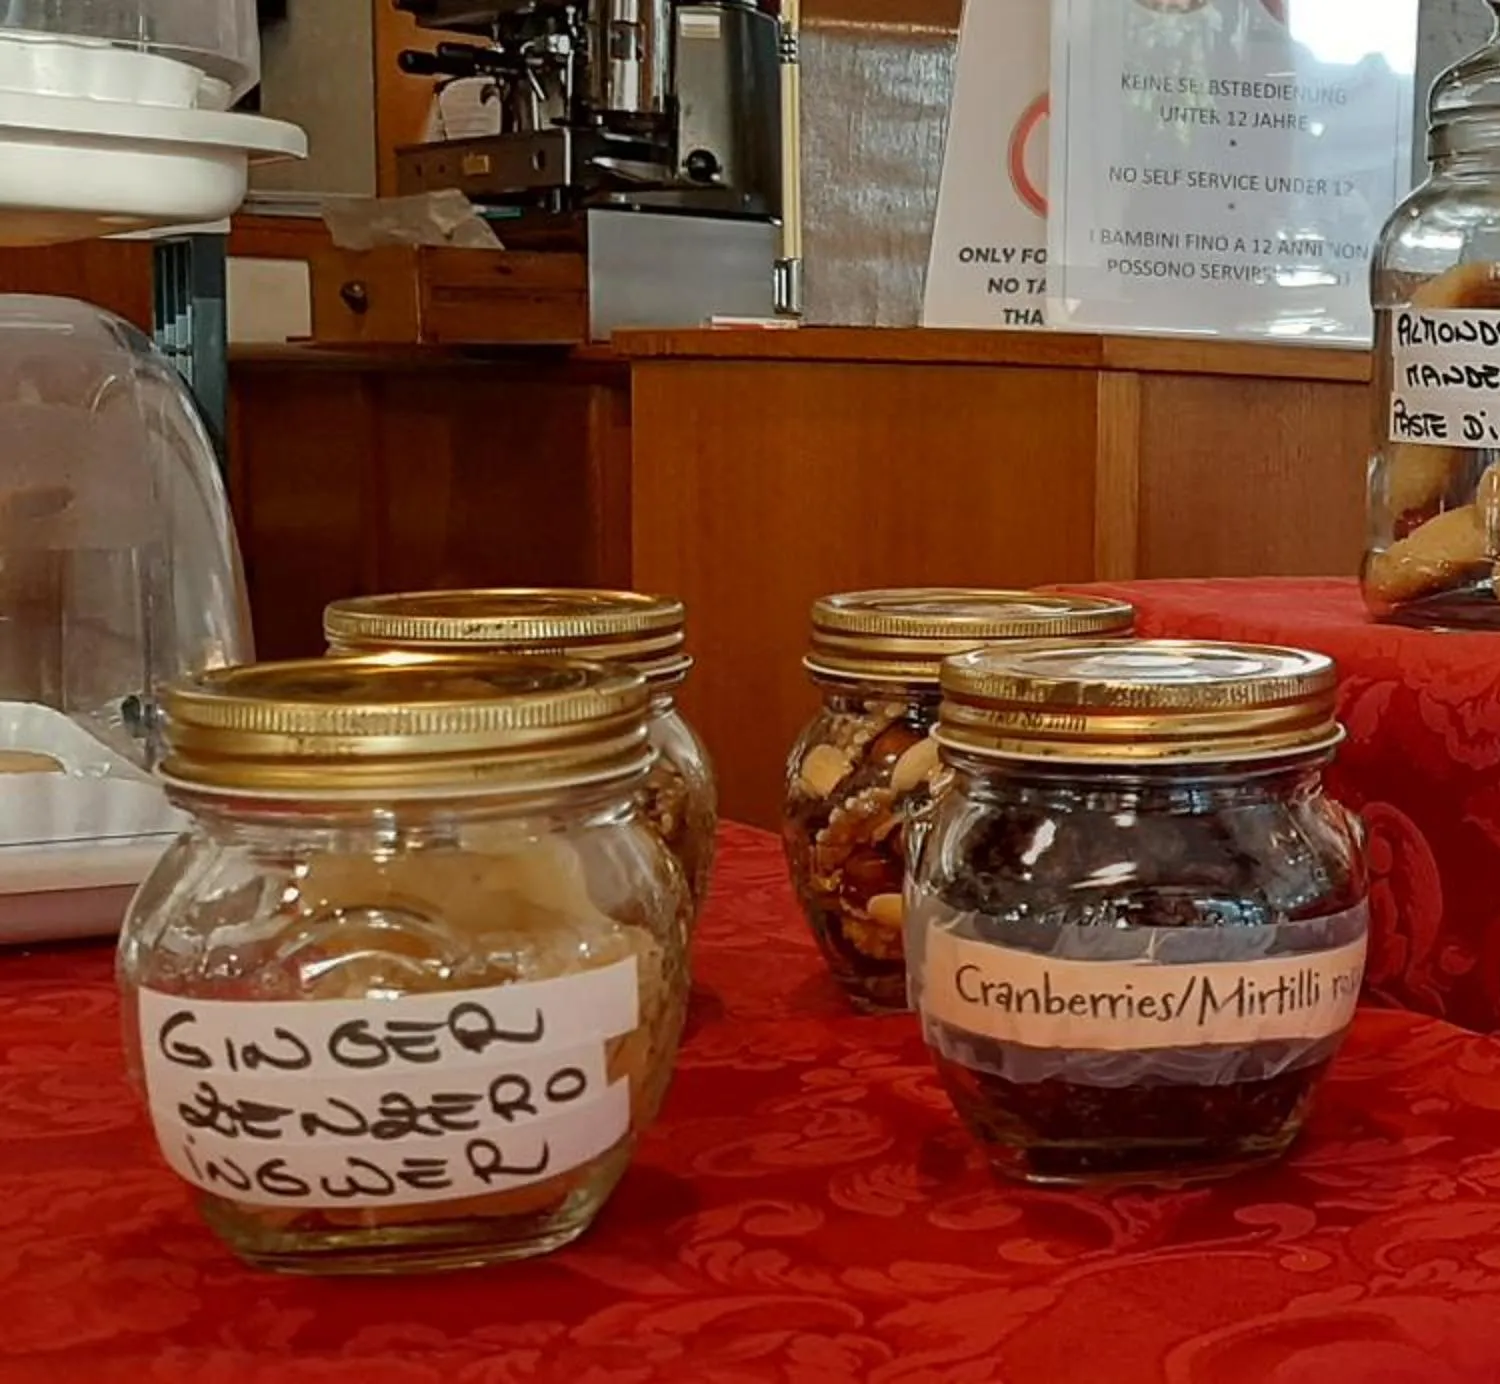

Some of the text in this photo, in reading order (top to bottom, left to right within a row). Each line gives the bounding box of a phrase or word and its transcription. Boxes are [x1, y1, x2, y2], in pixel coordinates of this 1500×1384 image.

[1120, 73, 1347, 105] KEINE SEBSTBEDIENUNG
[1160, 106, 1309, 131] UNTER 12 JAHRE
[1109, 167, 1137, 184] NO
[1143, 169, 1184, 186] SELF
[1187, 171, 1259, 192] SERVICE
[1265, 176, 1327, 196] UNDER
[959, 247, 1016, 263] ONLY
[1101, 229, 1180, 251] BAMBINI
[1186, 233, 1229, 252] FINO
[1234, 237, 1246, 253] A
[1253, 237, 1273, 256] 12
[1277, 238, 1324, 258] ANNI
[1333, 242, 1369, 261] NON
[1108, 258, 1195, 279] POSSONO
[988, 278, 1019, 294] NO
[1003, 308, 1044, 325] THA
[1392, 399, 1448, 439] PASTE
[955, 964, 1321, 1026] Cranberries/Mirtilli
[159, 1002, 544, 1073] GINGER
[178, 1067, 587, 1141] ZENZERO
